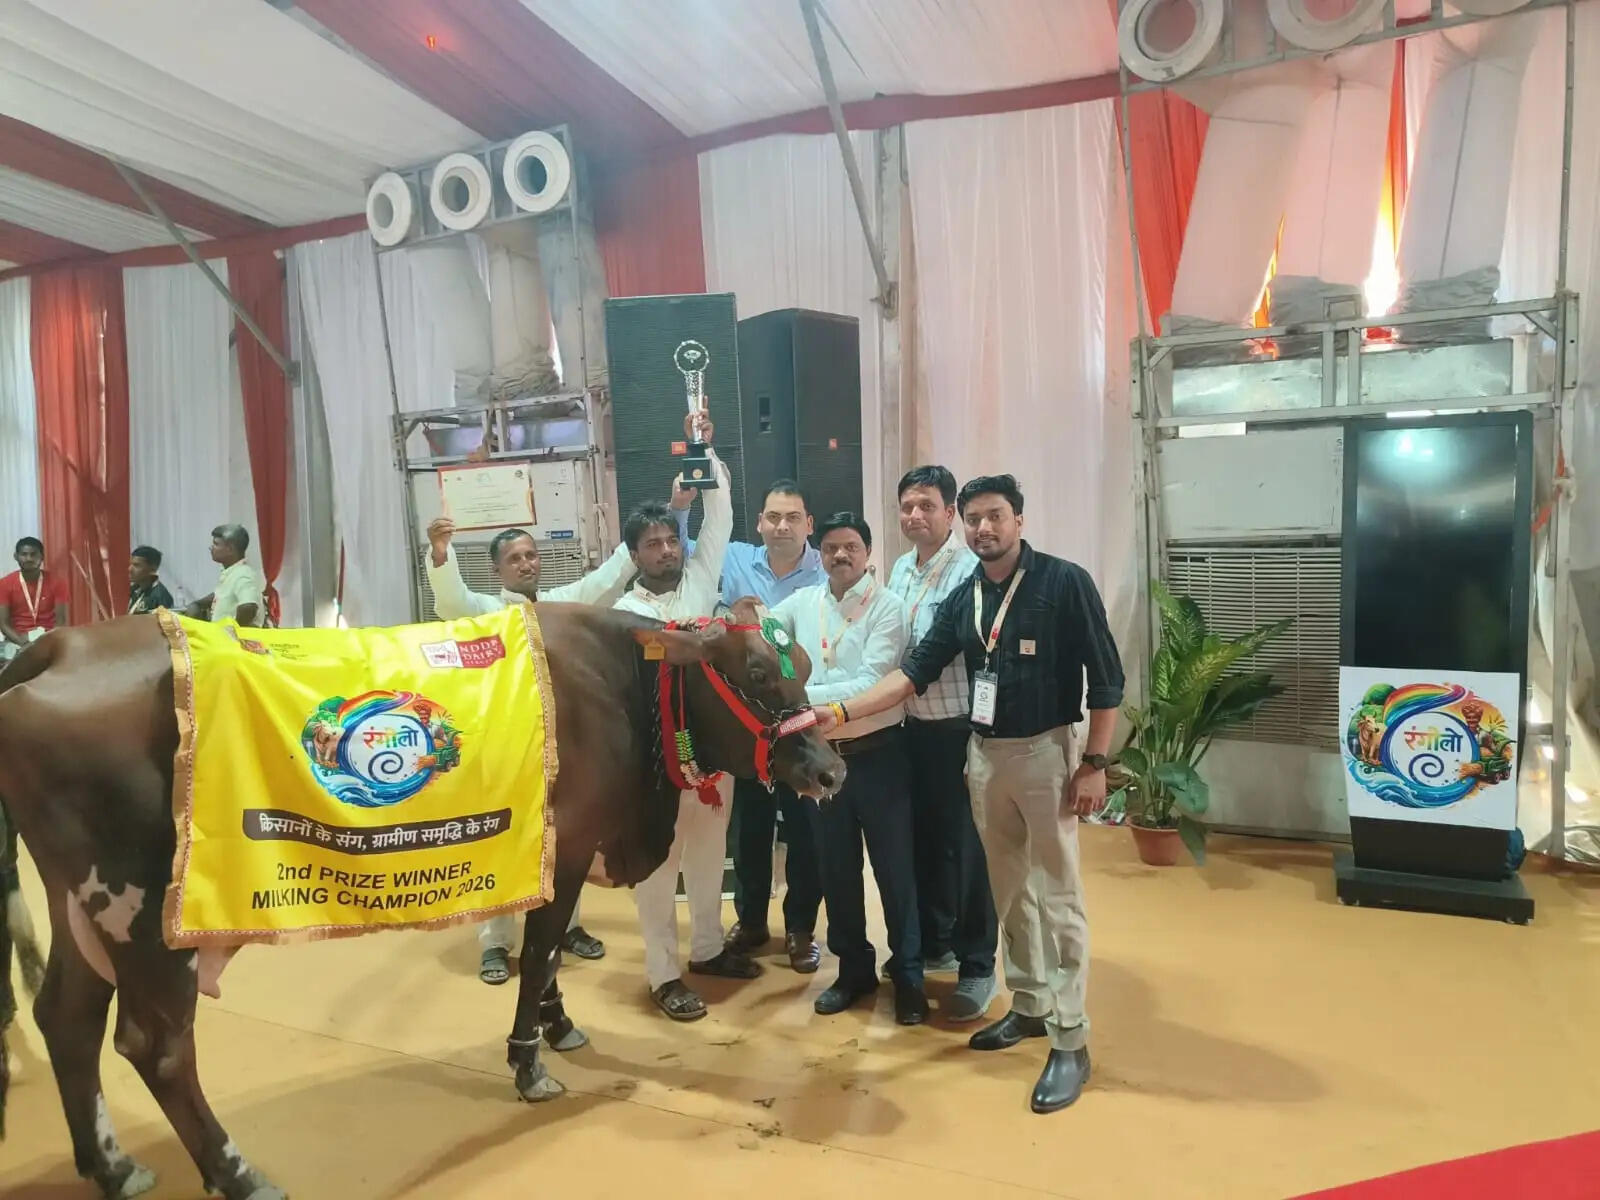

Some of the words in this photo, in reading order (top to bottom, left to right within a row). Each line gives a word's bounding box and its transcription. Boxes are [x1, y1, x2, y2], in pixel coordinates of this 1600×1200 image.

[315, 824, 333, 842] के
[335, 831, 367, 852] संग,
[372, 827, 418, 848] ग्रामीण
[420, 821, 464, 845] समृद्धि
[465, 818, 482, 835] के
[483, 816, 501, 832] रंग
[251, 887, 329, 910] MILKING
[336, 885, 452, 911] CHAMPION
[455, 873, 496, 898] 2026
[277, 862, 312, 880] 2nd
[319, 866, 387, 889] PRIZE
[393, 860, 472, 888] WINNER
